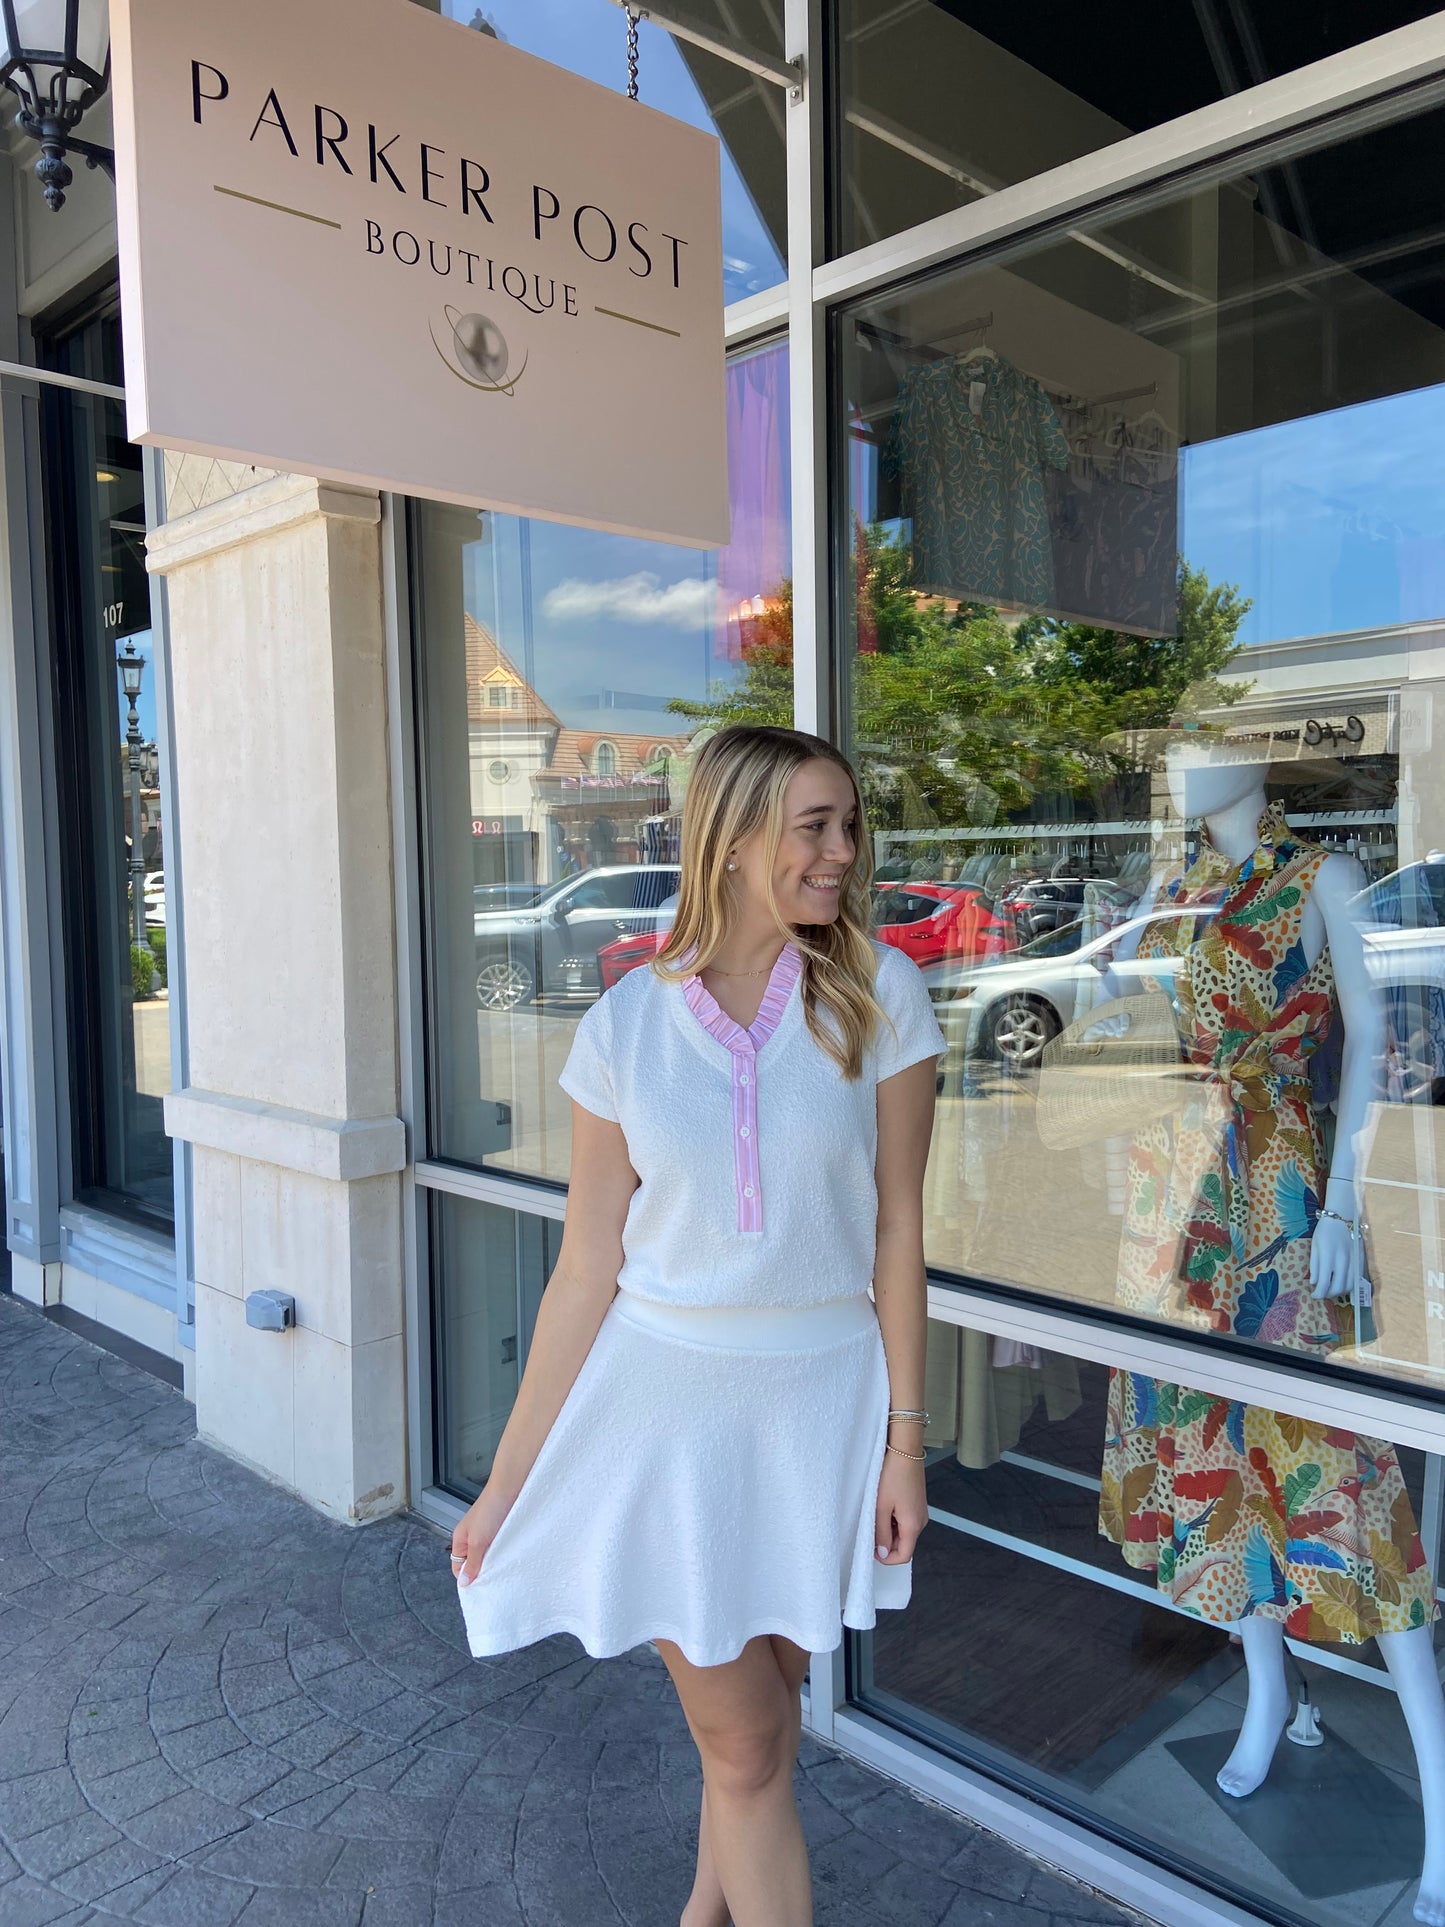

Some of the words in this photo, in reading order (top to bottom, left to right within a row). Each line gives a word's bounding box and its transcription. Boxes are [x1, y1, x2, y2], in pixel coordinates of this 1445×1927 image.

[190, 59, 495, 225] PARKER
[532, 184, 689, 289] POST
[364, 218, 580, 317] BOUTIQUE
[103, 601, 124, 629] 107
